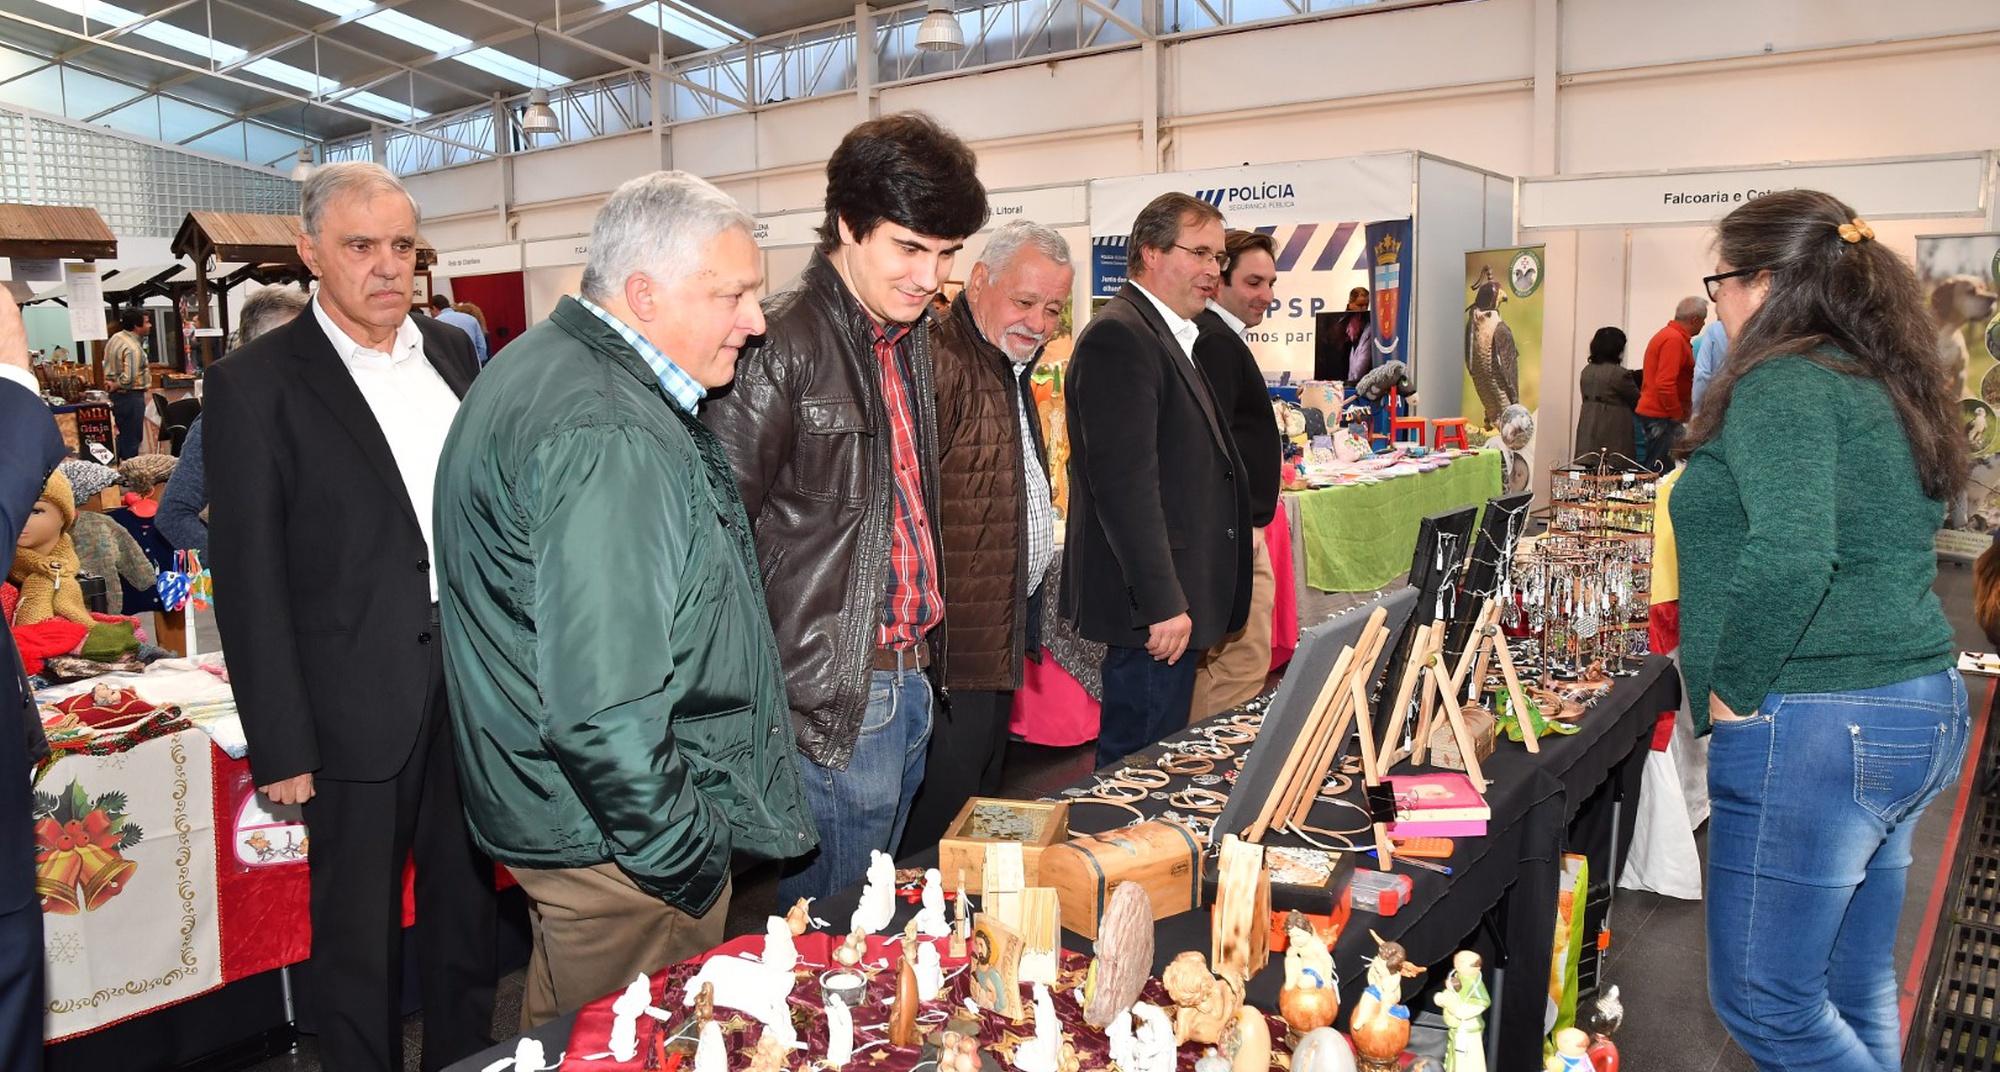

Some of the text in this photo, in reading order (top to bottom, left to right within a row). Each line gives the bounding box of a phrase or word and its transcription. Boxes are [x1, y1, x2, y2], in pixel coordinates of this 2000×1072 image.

[1228, 181, 1294, 202] POLÍCIA
[1663, 191, 1729, 205] Falcoaria
[1733, 191, 1742, 202] e
[996, 205, 1023, 215] Litoral
[1245, 331, 1313, 345] mos par
[80, 424, 110, 434] Ginja
